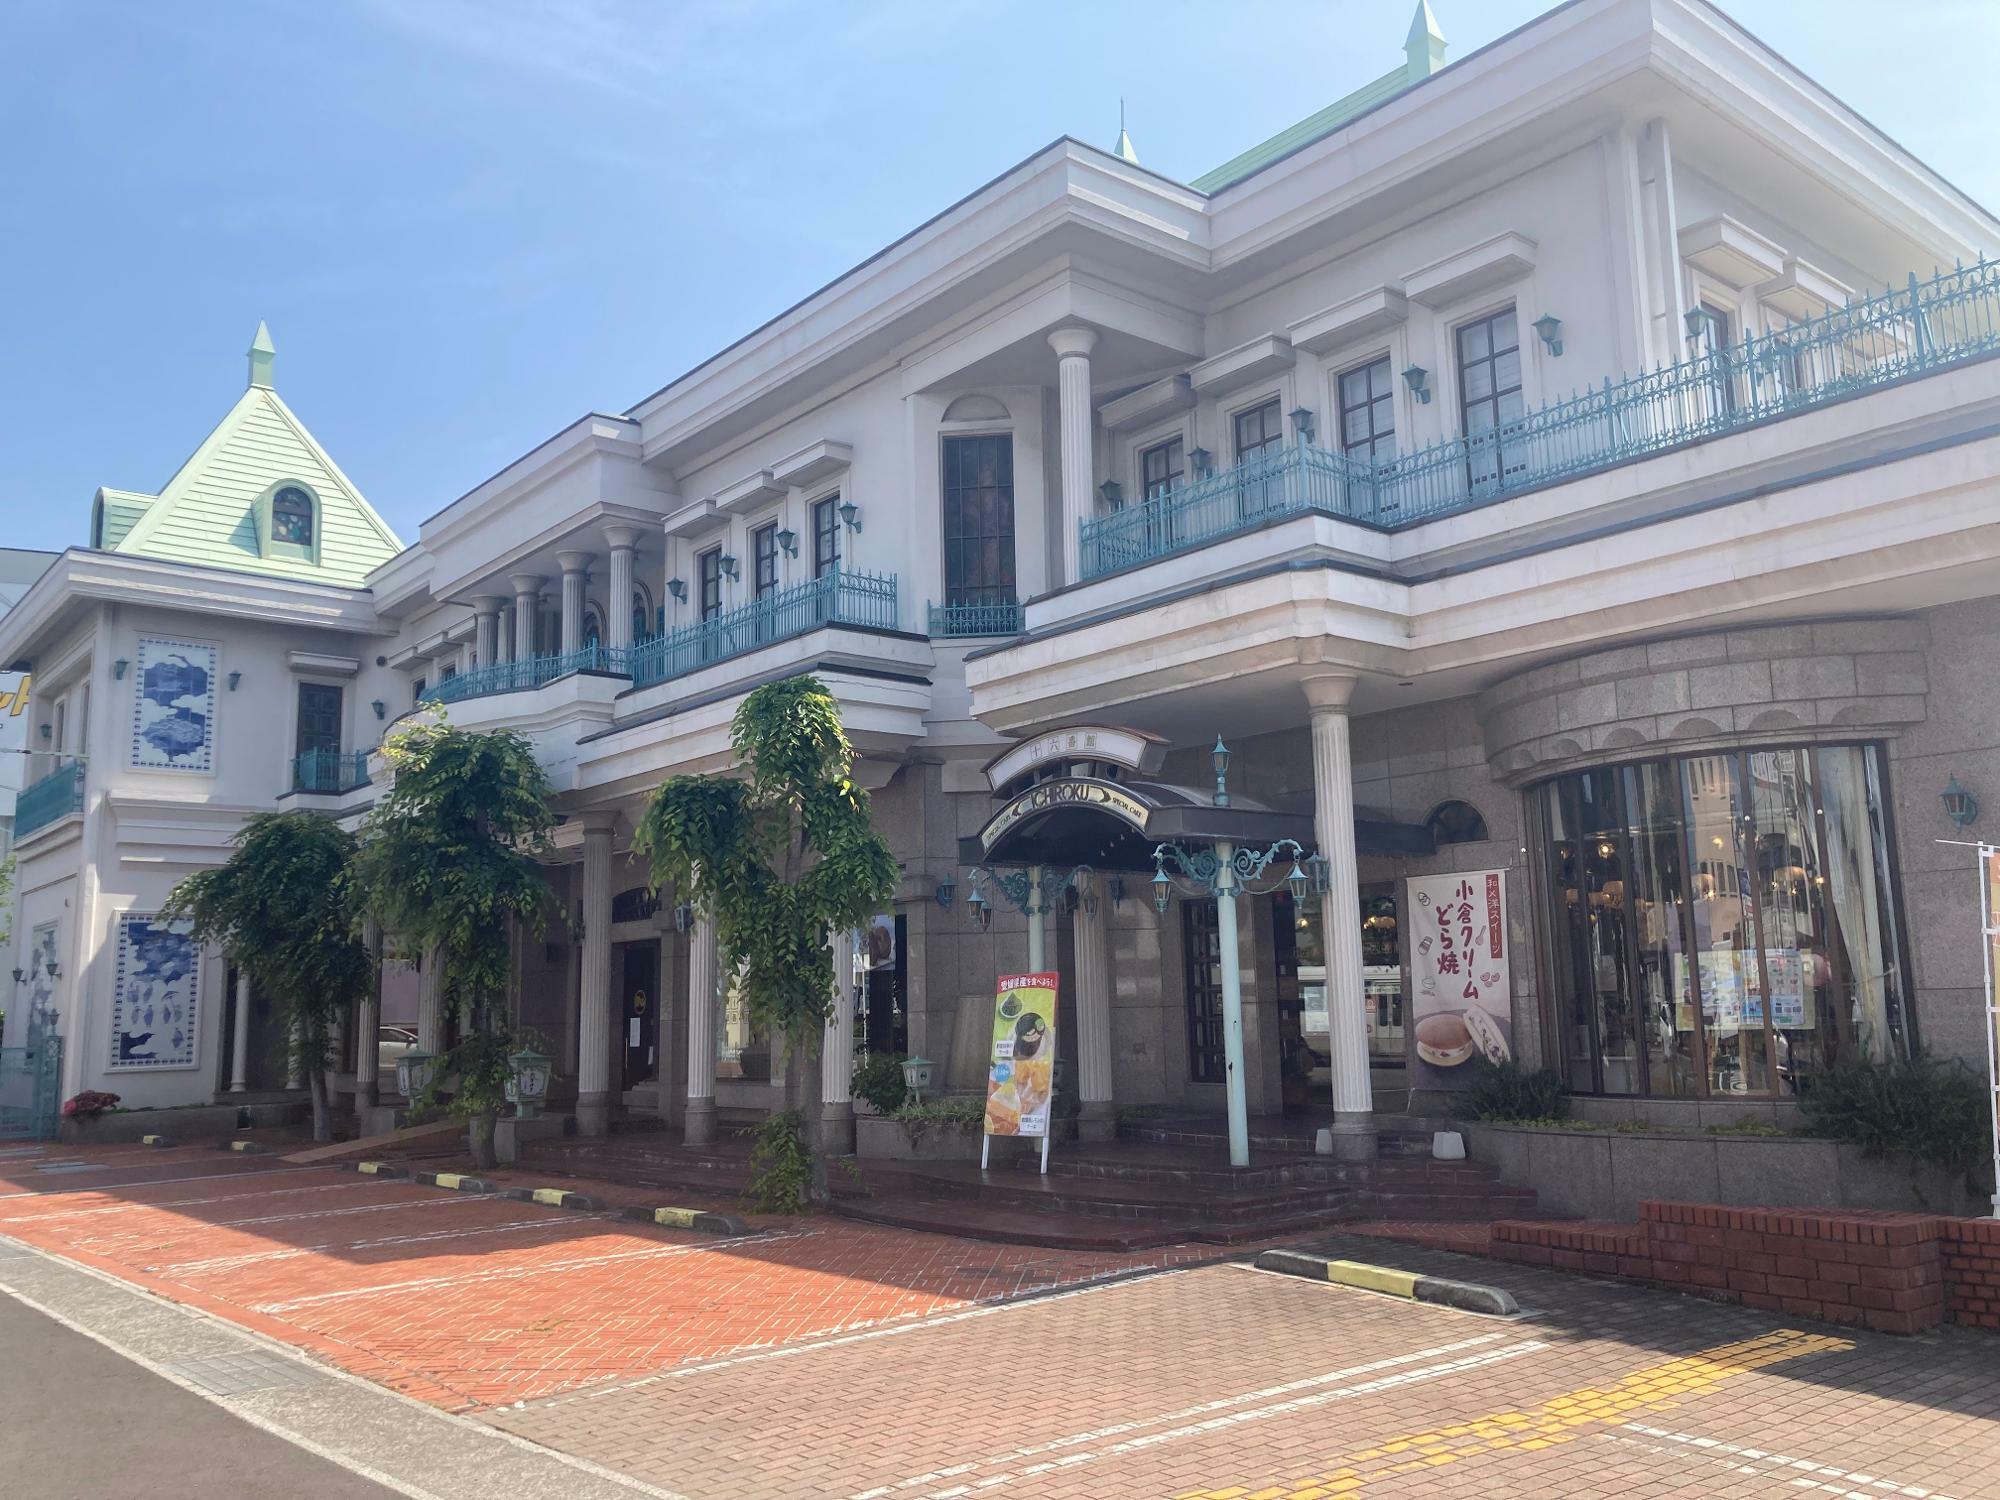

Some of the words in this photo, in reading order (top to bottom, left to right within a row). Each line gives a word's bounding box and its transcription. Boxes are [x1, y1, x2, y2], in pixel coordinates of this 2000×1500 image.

[1031, 733, 1097, 758] 十六番館
[1031, 784, 1090, 809] ICHIROKU
[1436, 903, 1460, 975] どら焼
[1456, 879, 1478, 999] 小倉クリーム
